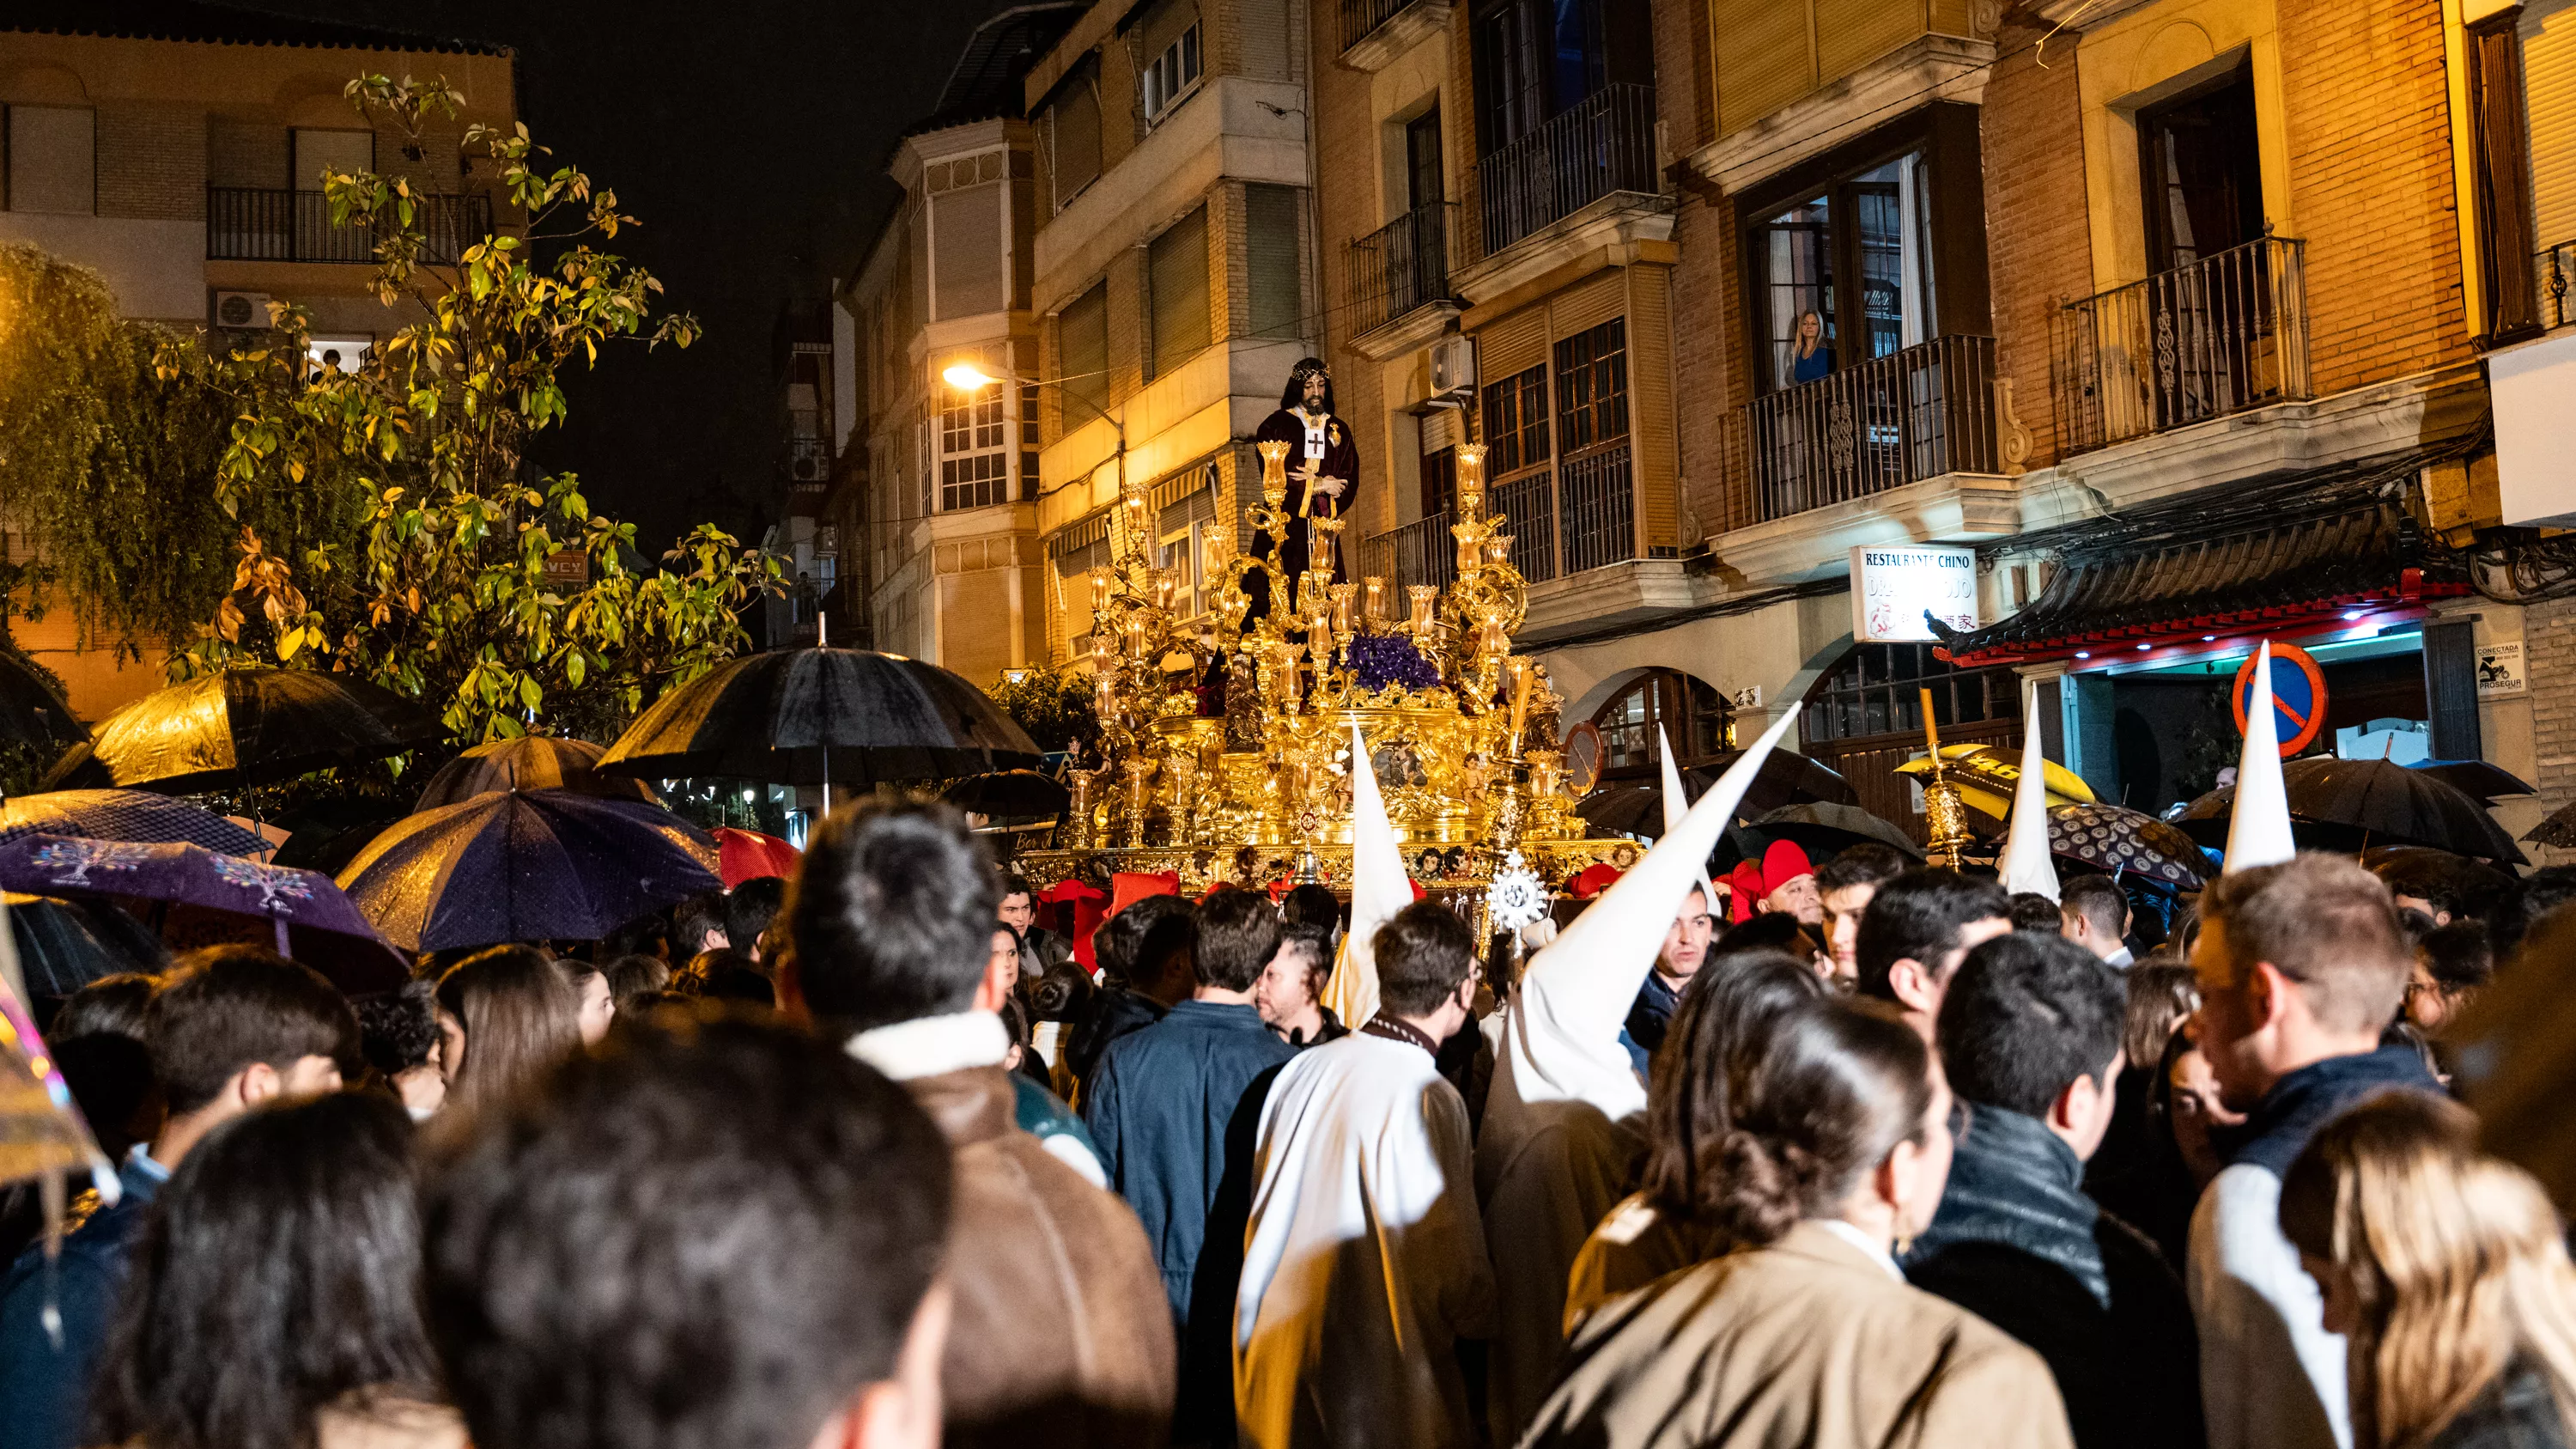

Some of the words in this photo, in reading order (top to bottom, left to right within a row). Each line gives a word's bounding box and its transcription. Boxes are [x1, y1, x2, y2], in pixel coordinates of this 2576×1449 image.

[1938, 555, 1969, 569] CHINO
[2477, 645, 2518, 654] CONECTADA
[2479, 679, 2522, 689] PROSEGUR
[1967, 757, 2020, 780] 46
[1014, 832, 1036, 850] Bar
